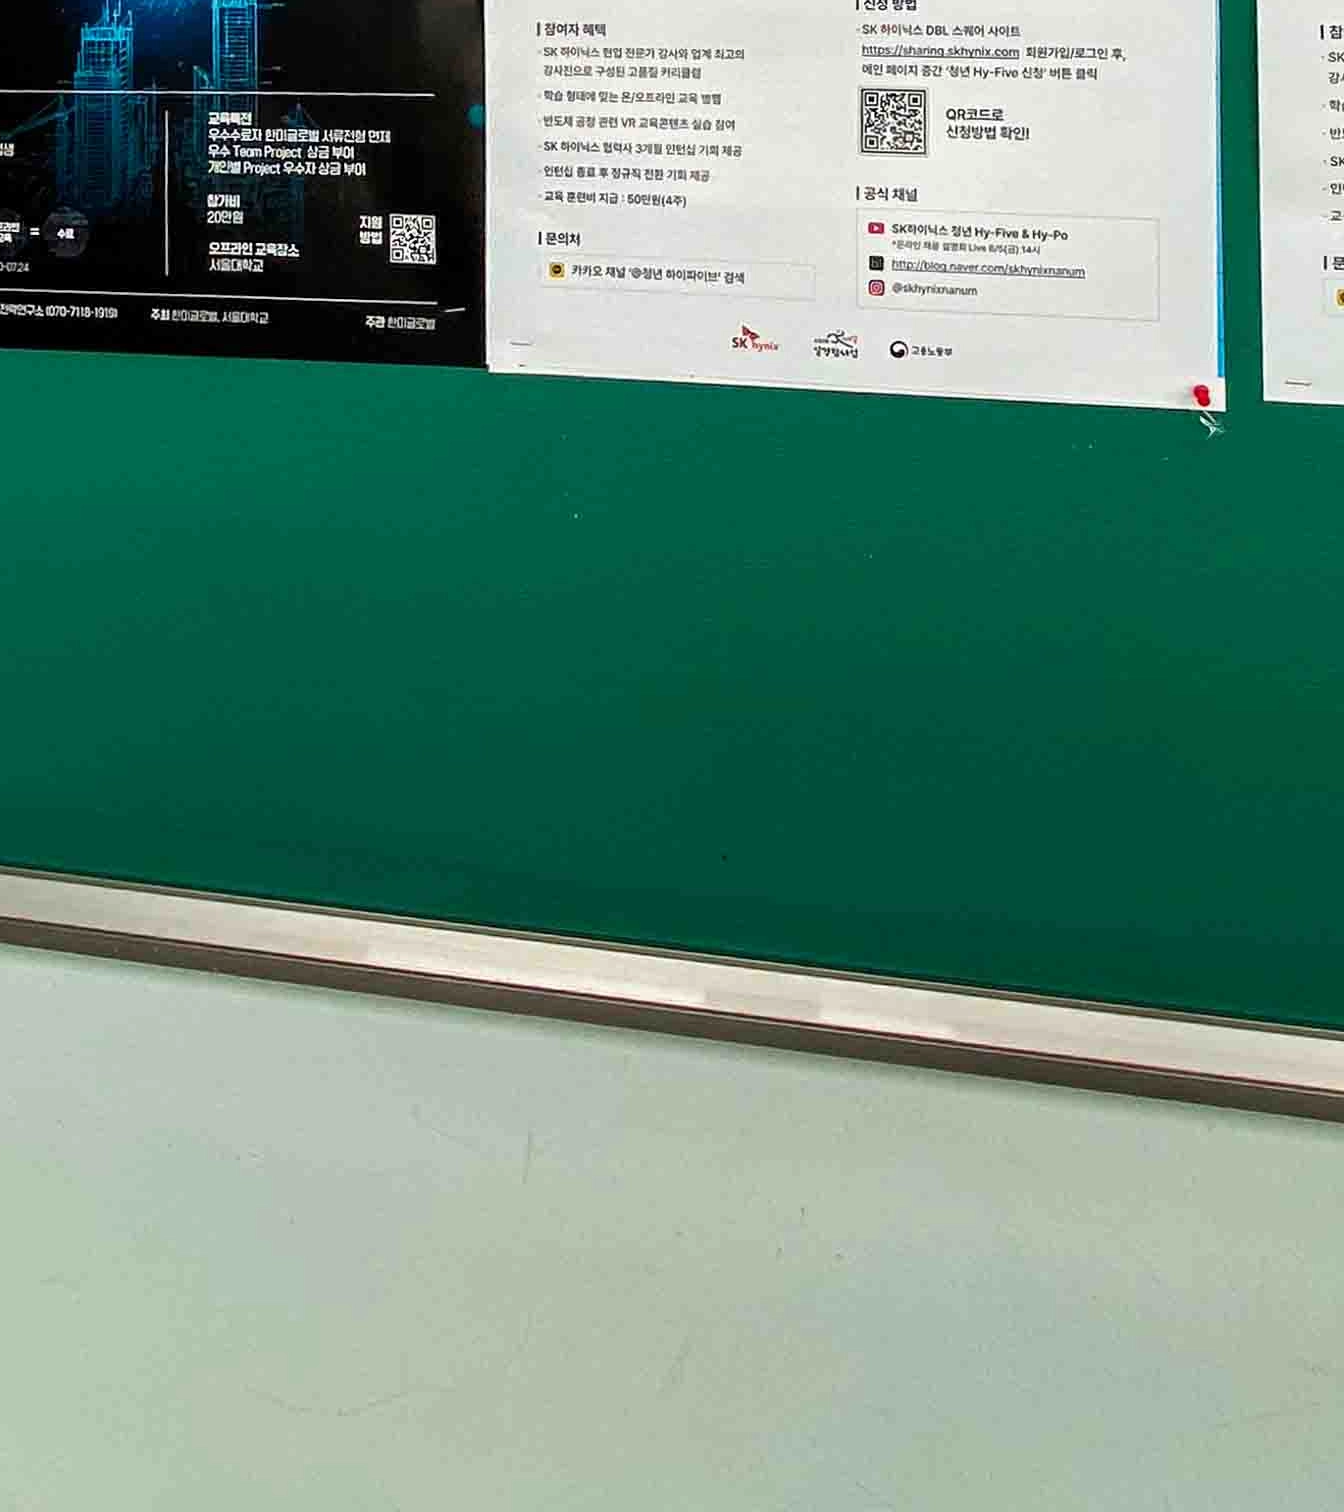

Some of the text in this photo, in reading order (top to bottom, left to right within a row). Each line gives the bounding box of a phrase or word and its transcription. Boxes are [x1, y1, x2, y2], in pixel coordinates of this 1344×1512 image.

[545, 23, 579, 36] 참여자
[946, 109, 1004, 121] QR코드로
[208, 145, 354, 160] 우수 Team Project 상금 부여
[243, 161, 280, 176] Project
[283, 162, 316, 175] 우수자
[318, 162, 341, 175] 상금
[344, 163, 366, 176] 부여
[207, 194, 240, 208] 참가비
[864, 187, 918, 202] 공식 채널
[207, 211, 243, 224] 20만원
[546, 233, 580, 246] 문의처
[892, 224, 948, 236] SK하이닉스
[951, 226, 972, 237] 청년
[975, 227, 1018, 240] Hy-Five
[1032, 230, 1068, 242] Hy-Po
[209, 242, 253, 255] 오프라인
[209, 259, 263, 272] 서울대학교
